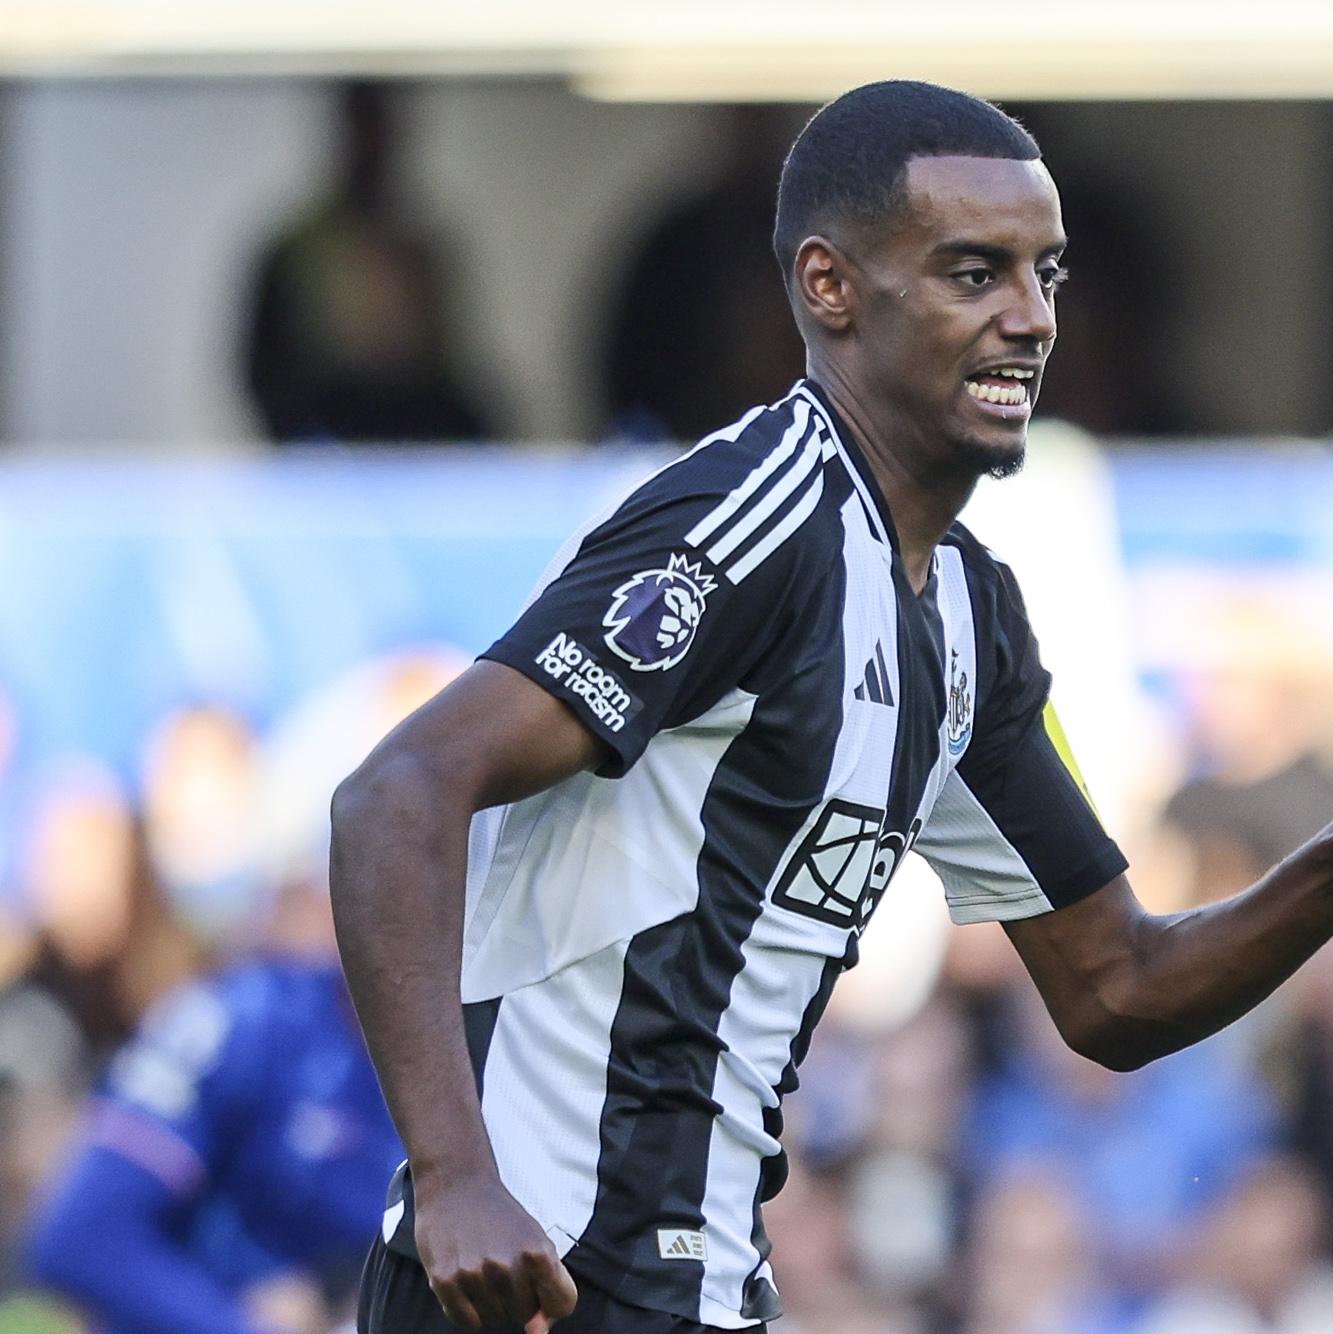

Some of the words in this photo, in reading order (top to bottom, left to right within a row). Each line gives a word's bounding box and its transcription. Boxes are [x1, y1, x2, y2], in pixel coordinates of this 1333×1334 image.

[546, 632, 583, 666] No
[578, 658, 631, 713] room
[563, 671, 626, 733] racism
